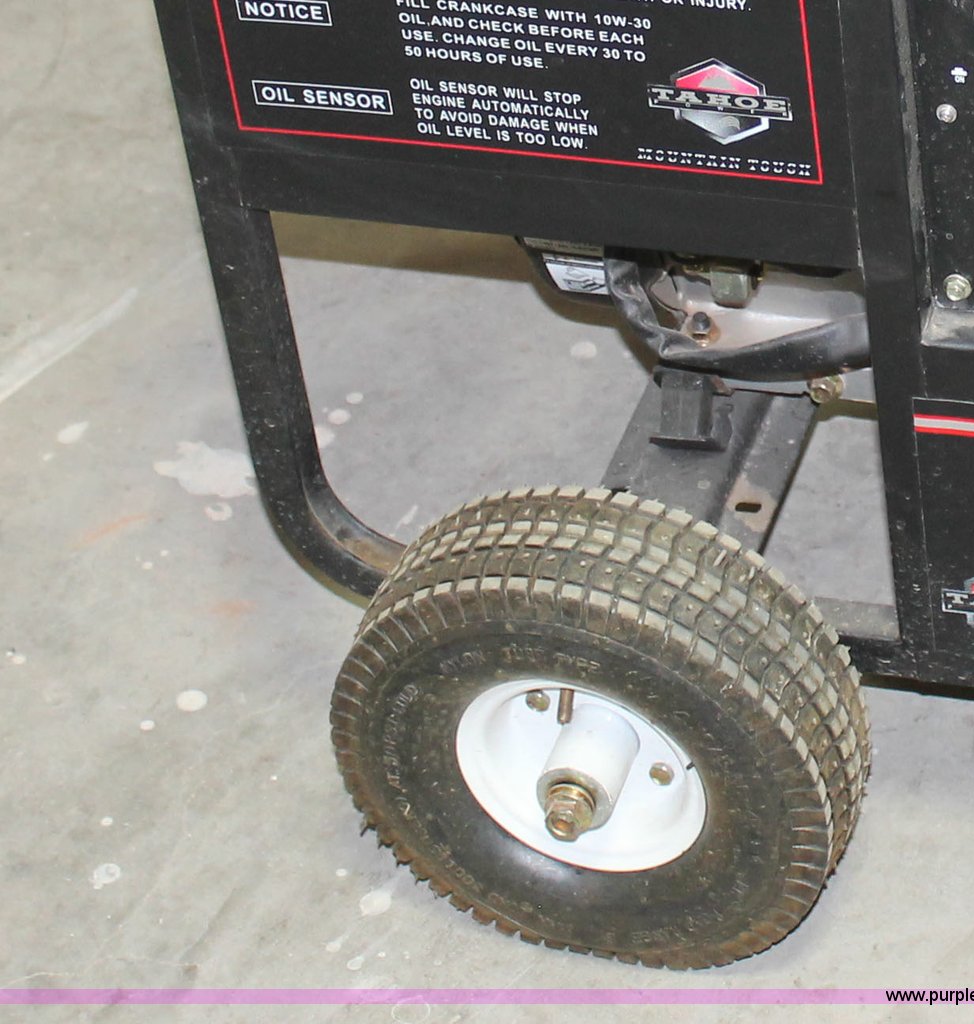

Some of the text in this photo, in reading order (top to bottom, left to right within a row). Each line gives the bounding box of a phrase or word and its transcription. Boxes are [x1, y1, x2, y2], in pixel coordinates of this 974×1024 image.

[244, 0, 324, 21] NOTICE
[261, 86, 386, 110] OIL SENSOR
[410, 78, 582, 105] OIL SENSOR WILL STOP
[651, 87, 788, 112] TAHOE
[412, 93, 590, 121] ENGINE AUTOMATICALLY
[637, 147, 812, 177] MOUNTAIN TOUCH
